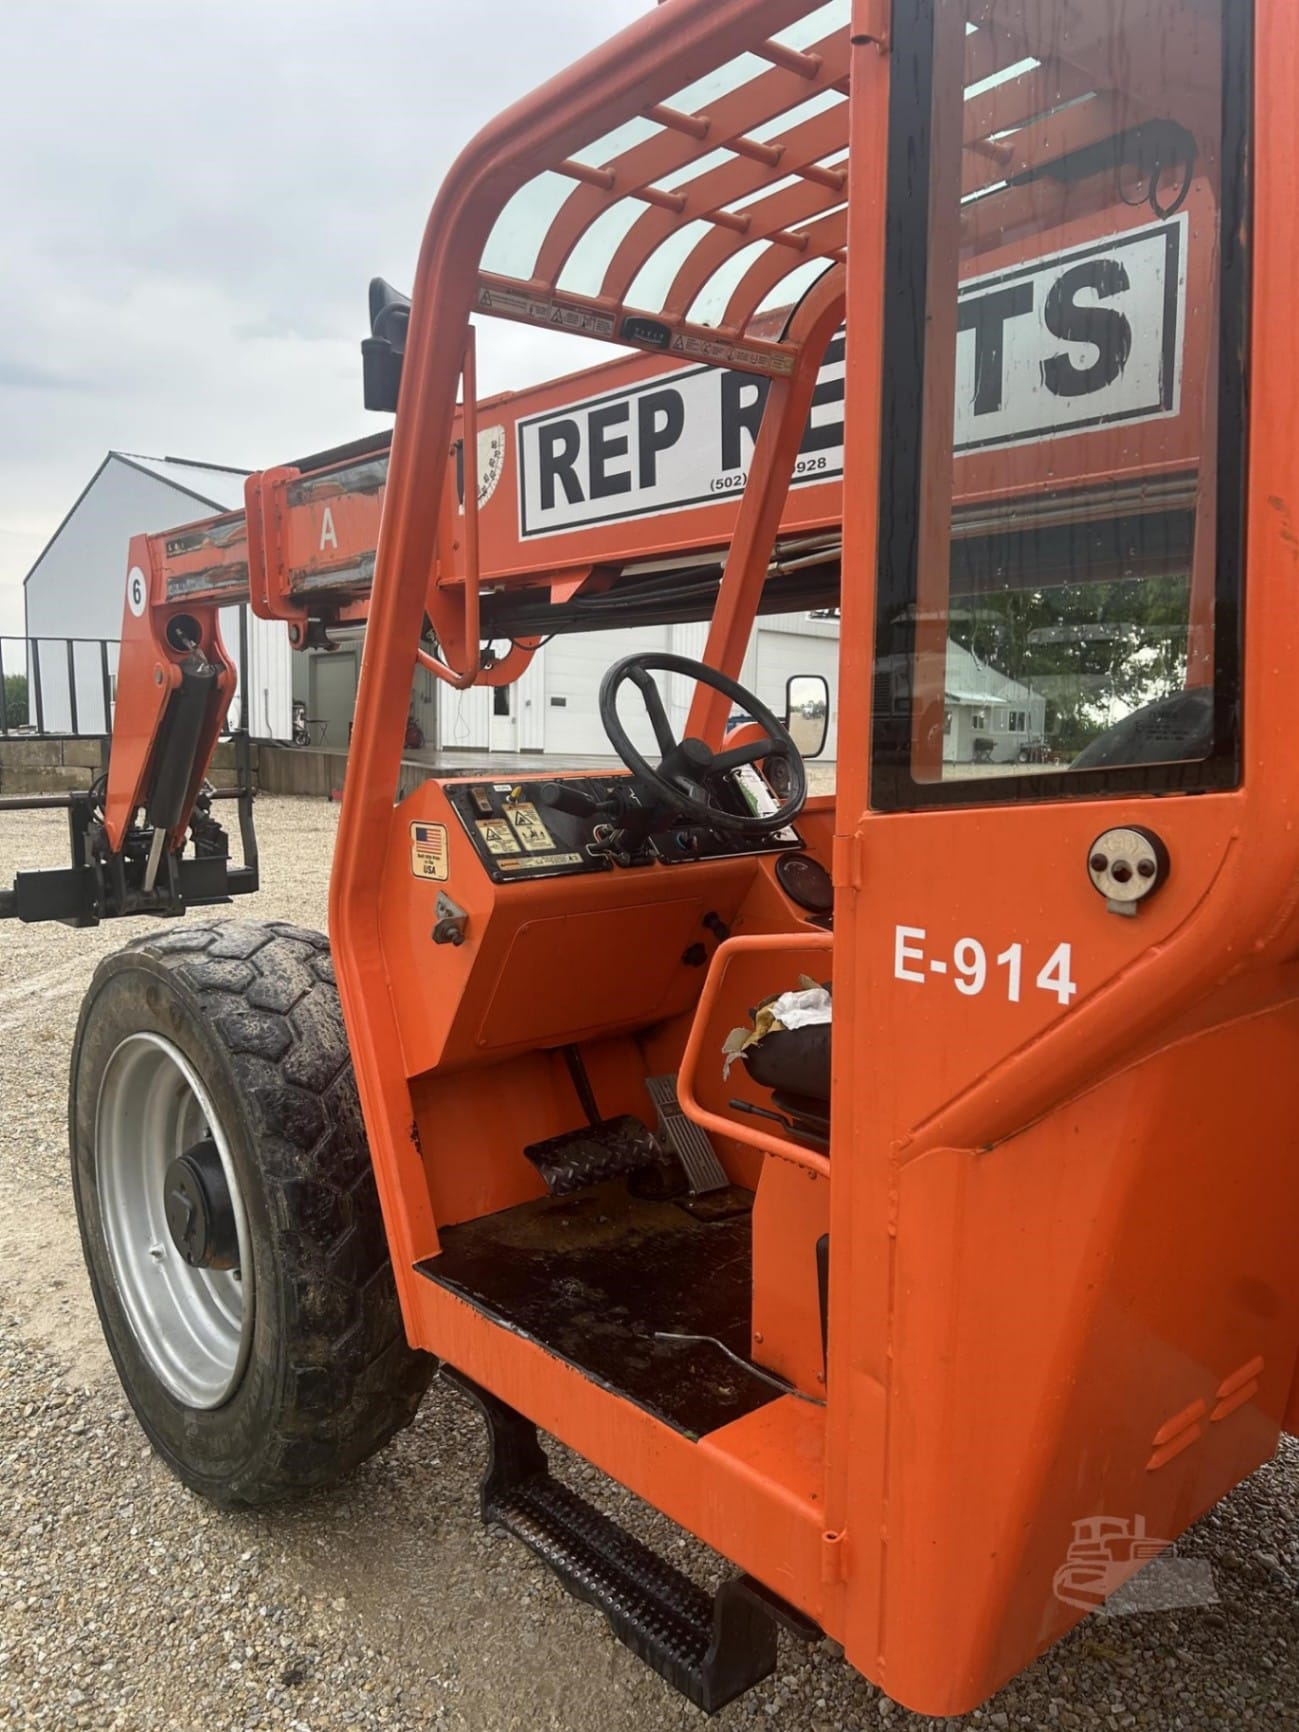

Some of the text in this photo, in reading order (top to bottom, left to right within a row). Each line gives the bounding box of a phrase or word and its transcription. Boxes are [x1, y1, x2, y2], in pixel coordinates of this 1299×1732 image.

[538, 388, 685, 511] REP
[710, 472, 748, 492] (502)
[319, 507, 338, 551] A
[132, 578, 142, 605] 6
[894, 924, 1077, 1006] E-914
